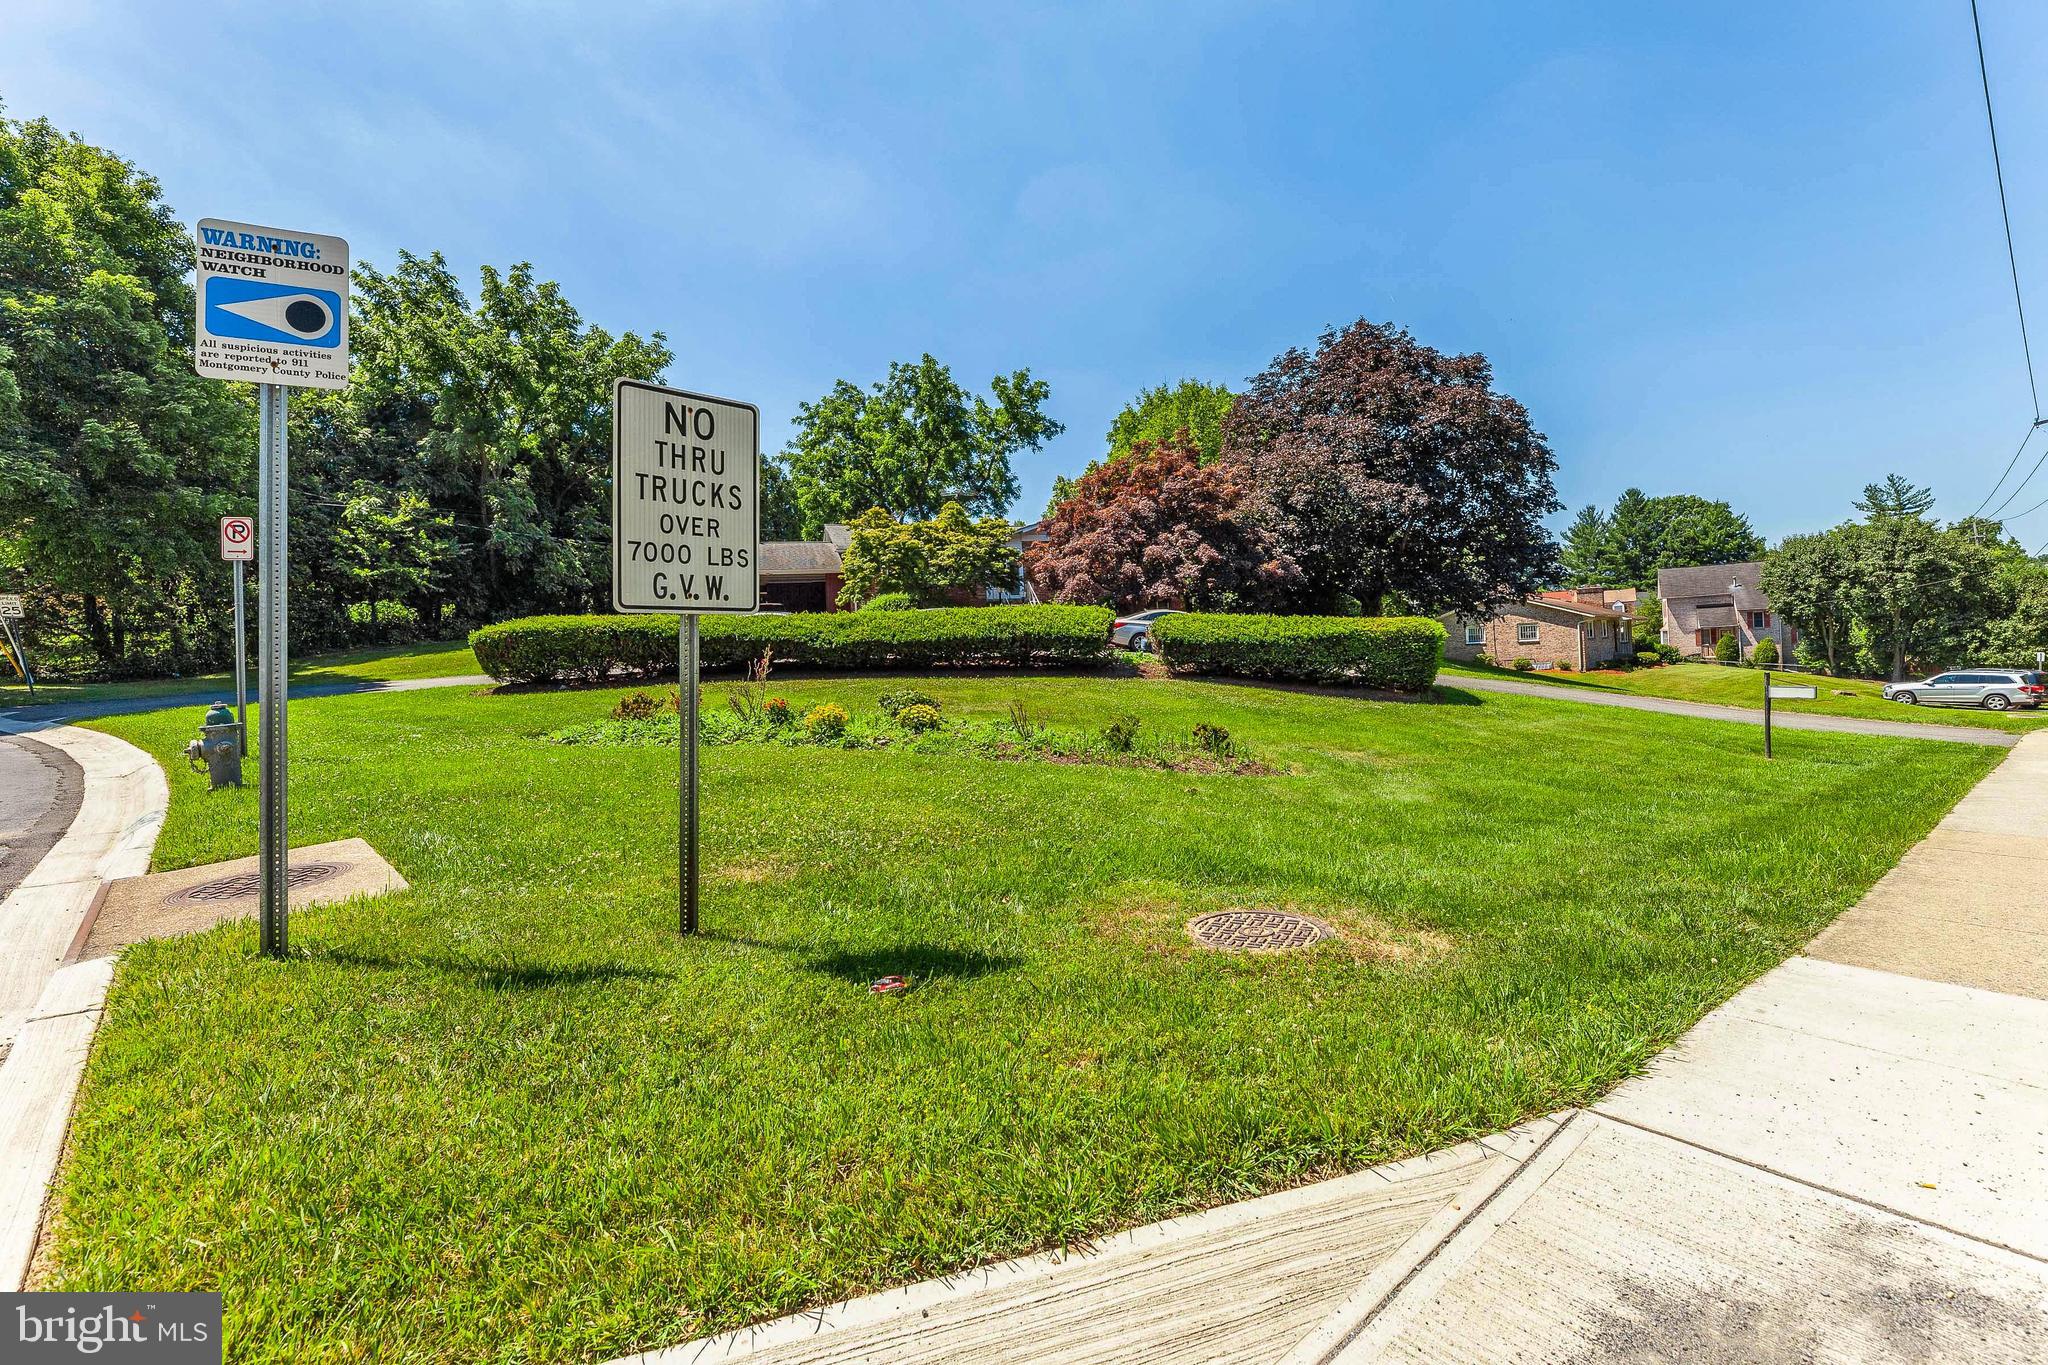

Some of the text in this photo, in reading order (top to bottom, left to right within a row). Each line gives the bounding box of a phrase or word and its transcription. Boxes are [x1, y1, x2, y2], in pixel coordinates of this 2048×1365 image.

[201, 227, 320, 260] WARNING:
[200, 247, 345, 275] NEIGHBORHOOD
[200, 261, 266, 278] WATCH
[200, 339, 332, 360] All suspicious activities
[224, 353, 272, 364] reported
[276, 357, 288, 366] to
[292, 358, 308, 367] 911
[199, 359, 346, 381] Montgomery County Police
[665, 401, 715, 441] NO
[655, 440, 725, 476] THRU
[635, 472, 742, 511] TRUCKS
[660, 513, 720, 538] OVER
[627, 541, 749, 568] 7000 LBS
[653, 572, 730, 602] G.V.W.
[1, 606, 22, 615] 25
